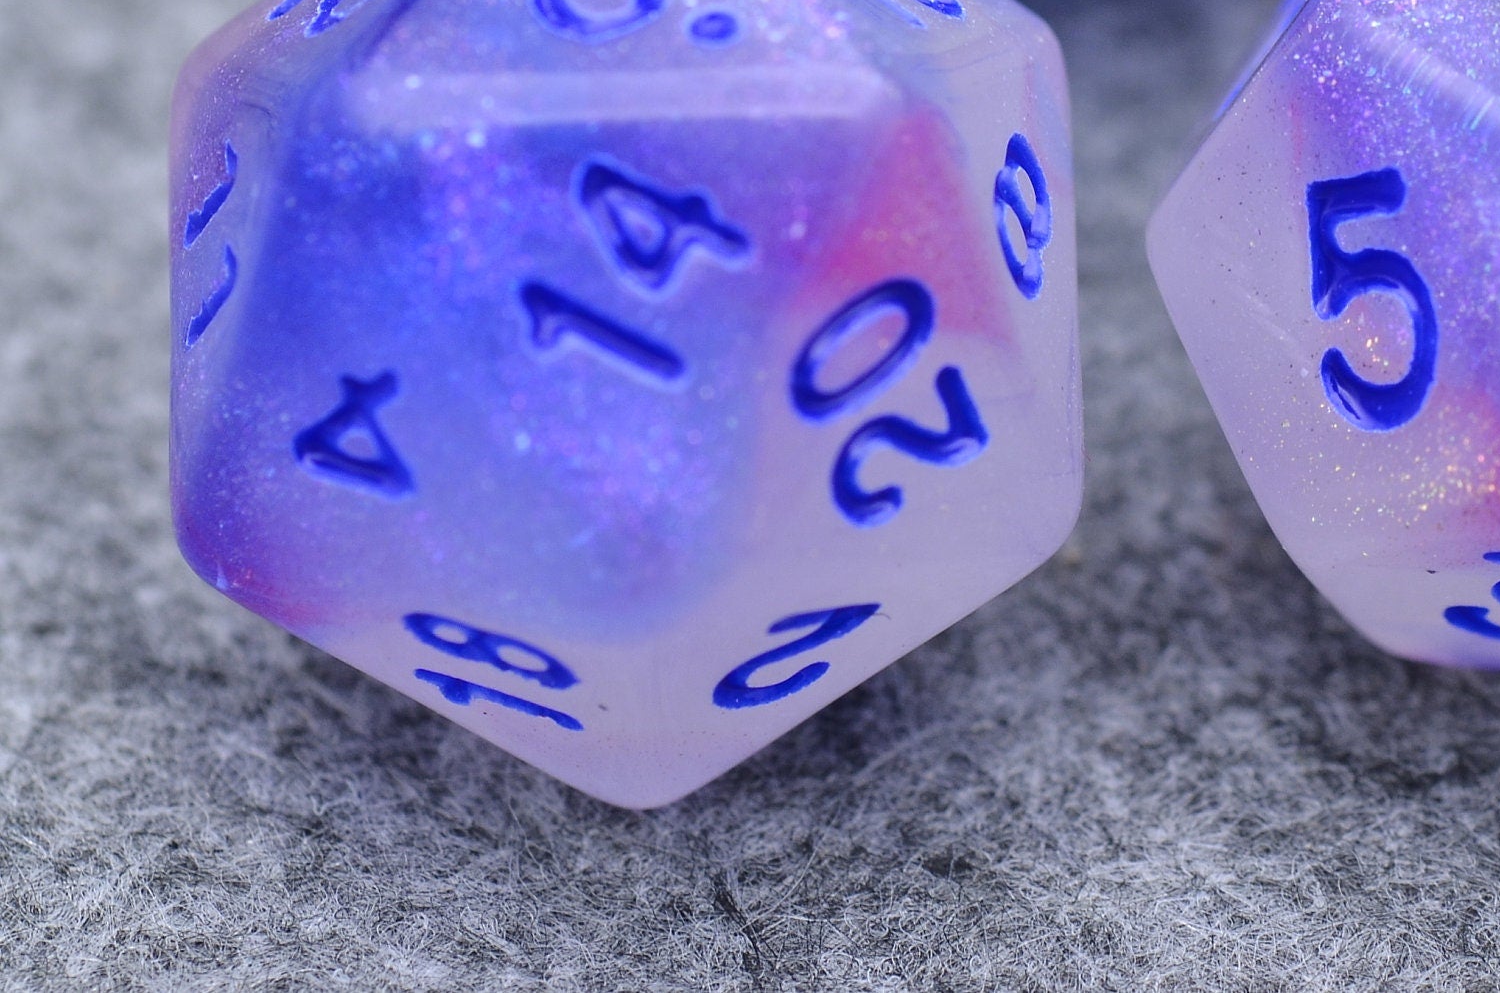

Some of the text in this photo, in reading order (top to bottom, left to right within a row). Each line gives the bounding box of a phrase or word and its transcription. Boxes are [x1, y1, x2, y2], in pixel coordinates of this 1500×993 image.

[520, 156, 756, 386] 14
[993, 131, 1053, 302] 8
[1305, 166, 1441, 433] 5
[293, 370, 420, 498] 4
[790, 276, 990, 528] 20
[402, 609, 585, 732] 18
[710, 601, 884, 712] 2
